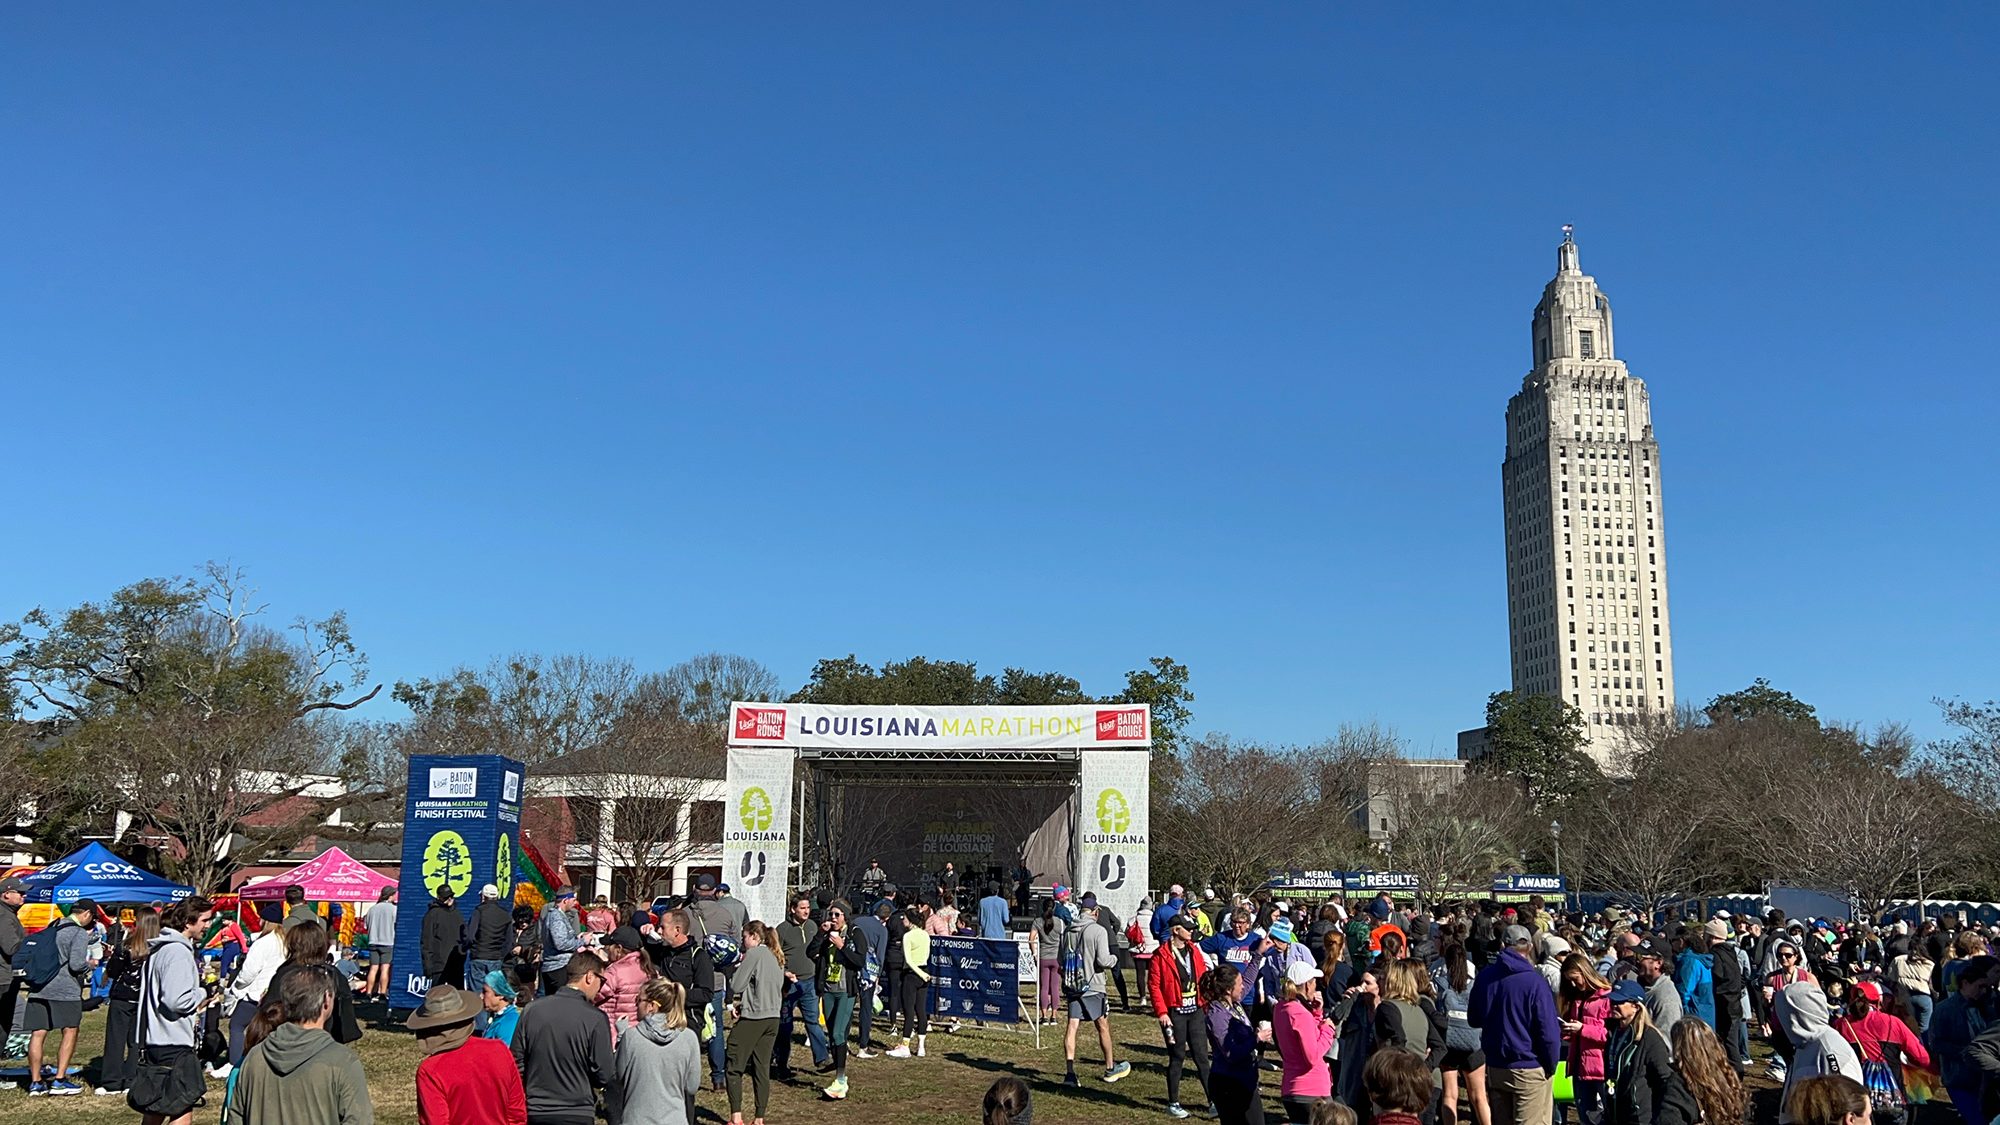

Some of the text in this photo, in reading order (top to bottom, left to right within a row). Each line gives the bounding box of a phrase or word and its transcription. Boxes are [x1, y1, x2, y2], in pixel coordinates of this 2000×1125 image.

[757, 712, 783, 725] BATON
[1117, 713, 1143, 725] BATON
[738, 718, 756, 730] Visit
[1099, 719, 1116, 733] Visit
[756, 725, 782, 738] ROUGE
[1117, 725, 1143, 738] ROUGE
[450, 771, 474, 783] BATON
[449, 783, 473, 795] ROUGE
[414, 810, 487, 818] FINISH FESTIVAL
[726, 832, 786, 841] LOUISIANA
[923, 834, 995, 842] AU MARATHON
[1083, 834, 1145, 844] LOUISIANA
[725, 841, 786, 850] MARATHON
[922, 843, 994, 852] DE LOUISIANE
[1083, 844, 1146, 854] MARATHON
[84, 862, 138, 875] COX
[1304, 870, 1334, 878] MEDAL
[1293, 878, 1342, 887] ENGRAVING
[1367, 874, 1420, 886] RESULTS
[1518, 878, 1560, 888] AWARDS
[172, 889, 192, 897] COX
[305, 888, 326, 896] learn
[337, 888, 360, 896] dream
[958, 978, 980, 990] COX
[1182, 996, 1196, 1007] 901
